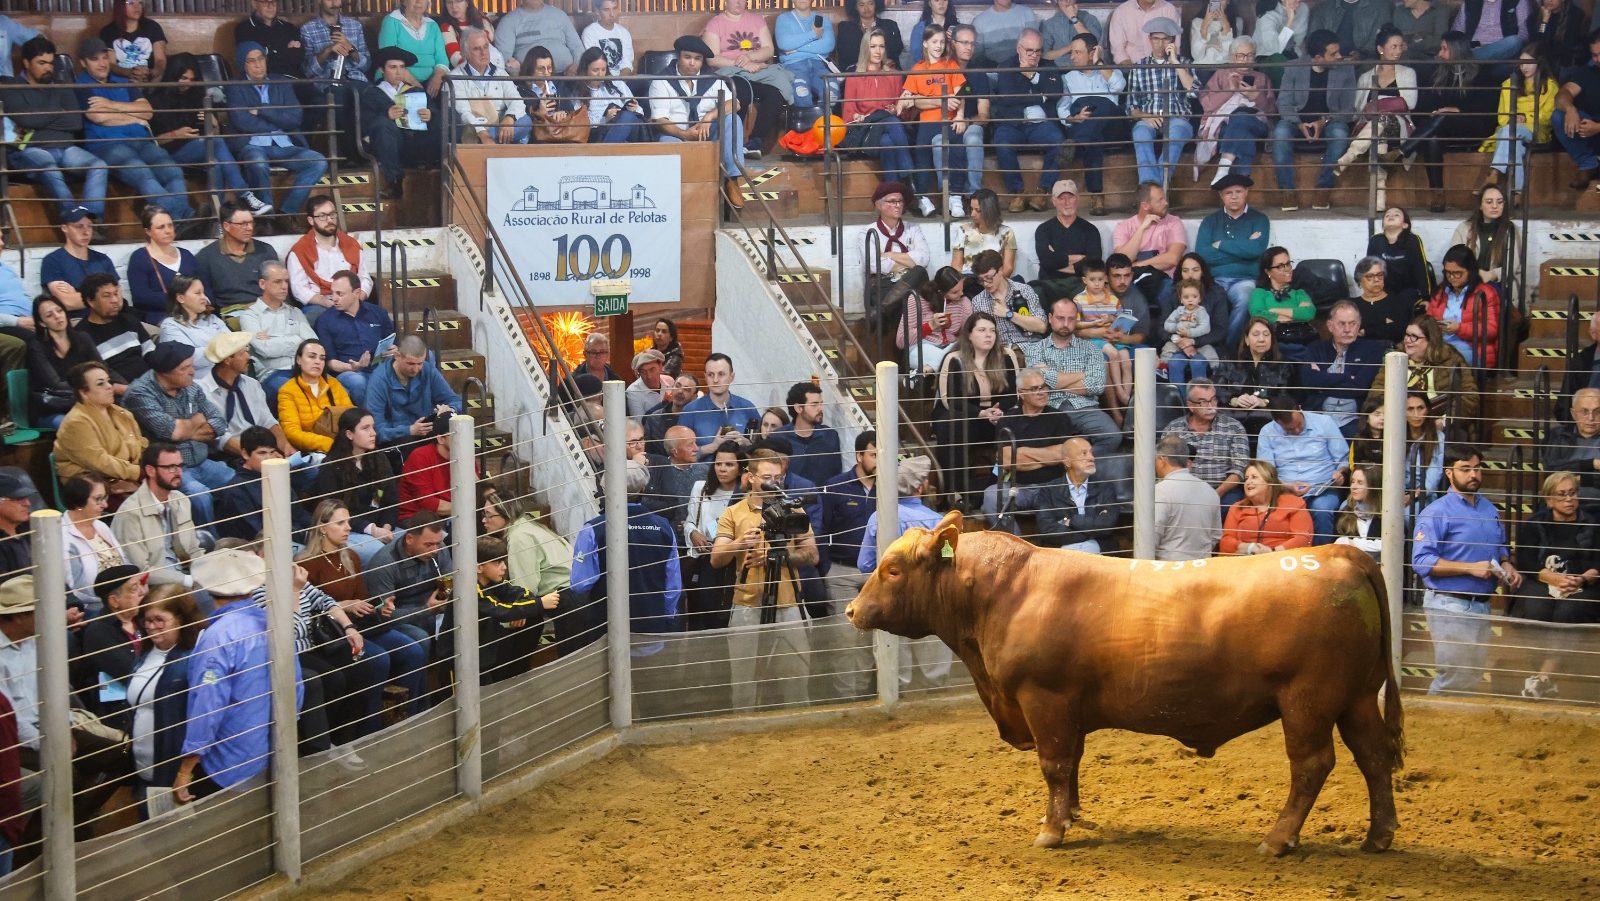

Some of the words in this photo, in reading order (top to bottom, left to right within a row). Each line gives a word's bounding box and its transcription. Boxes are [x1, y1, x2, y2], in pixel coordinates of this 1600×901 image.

[571, 211, 606, 225] Rural
[609, 211, 624, 224] de
[628, 210, 667, 223] Pelotas
[529, 272, 551, 281] 1898
[552, 233, 632, 281] 100
[629, 268, 651, 278] 1998
[1279, 554, 1321, 571] 05
